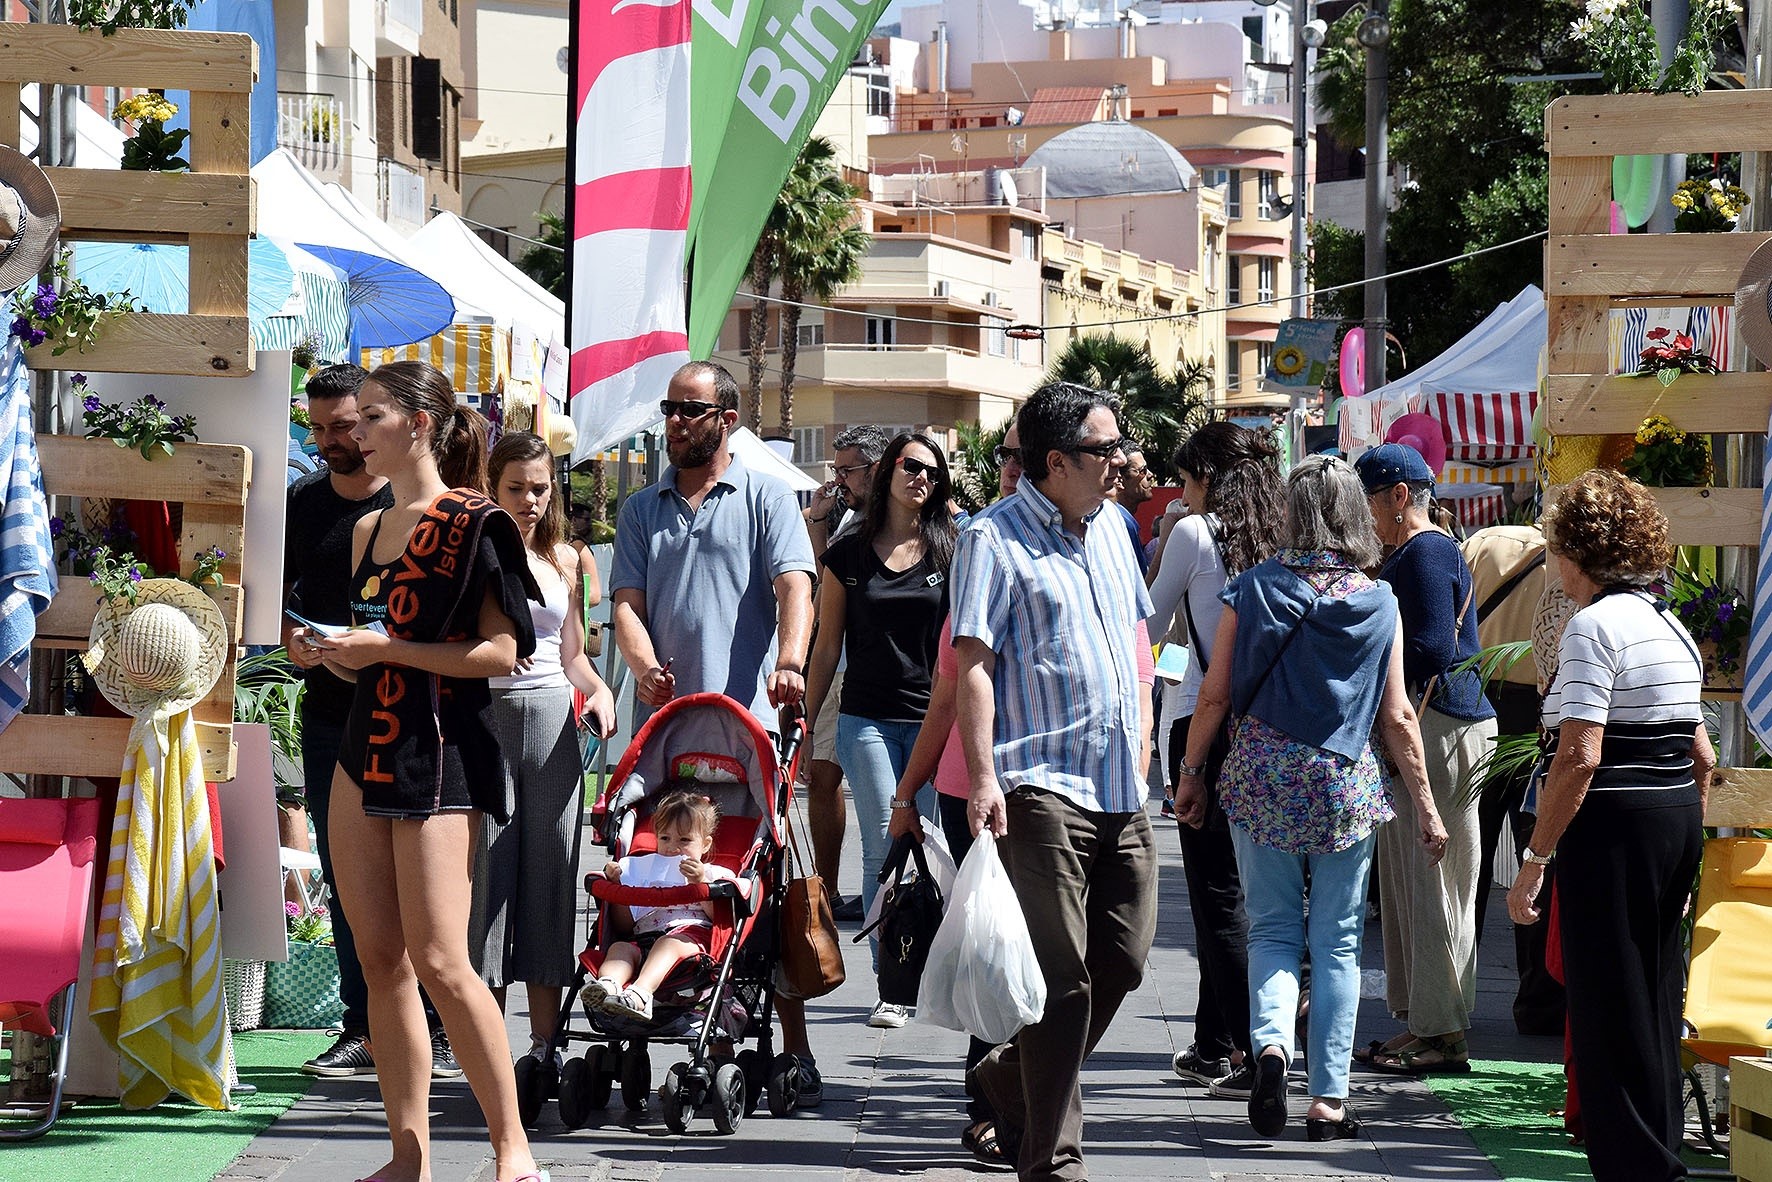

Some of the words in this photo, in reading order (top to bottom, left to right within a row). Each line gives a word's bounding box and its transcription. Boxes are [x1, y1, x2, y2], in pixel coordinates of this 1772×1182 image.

[737, 0, 872, 145] Bin
[433, 512, 470, 578] Islas
[350, 601, 388, 613] Fuerteven
